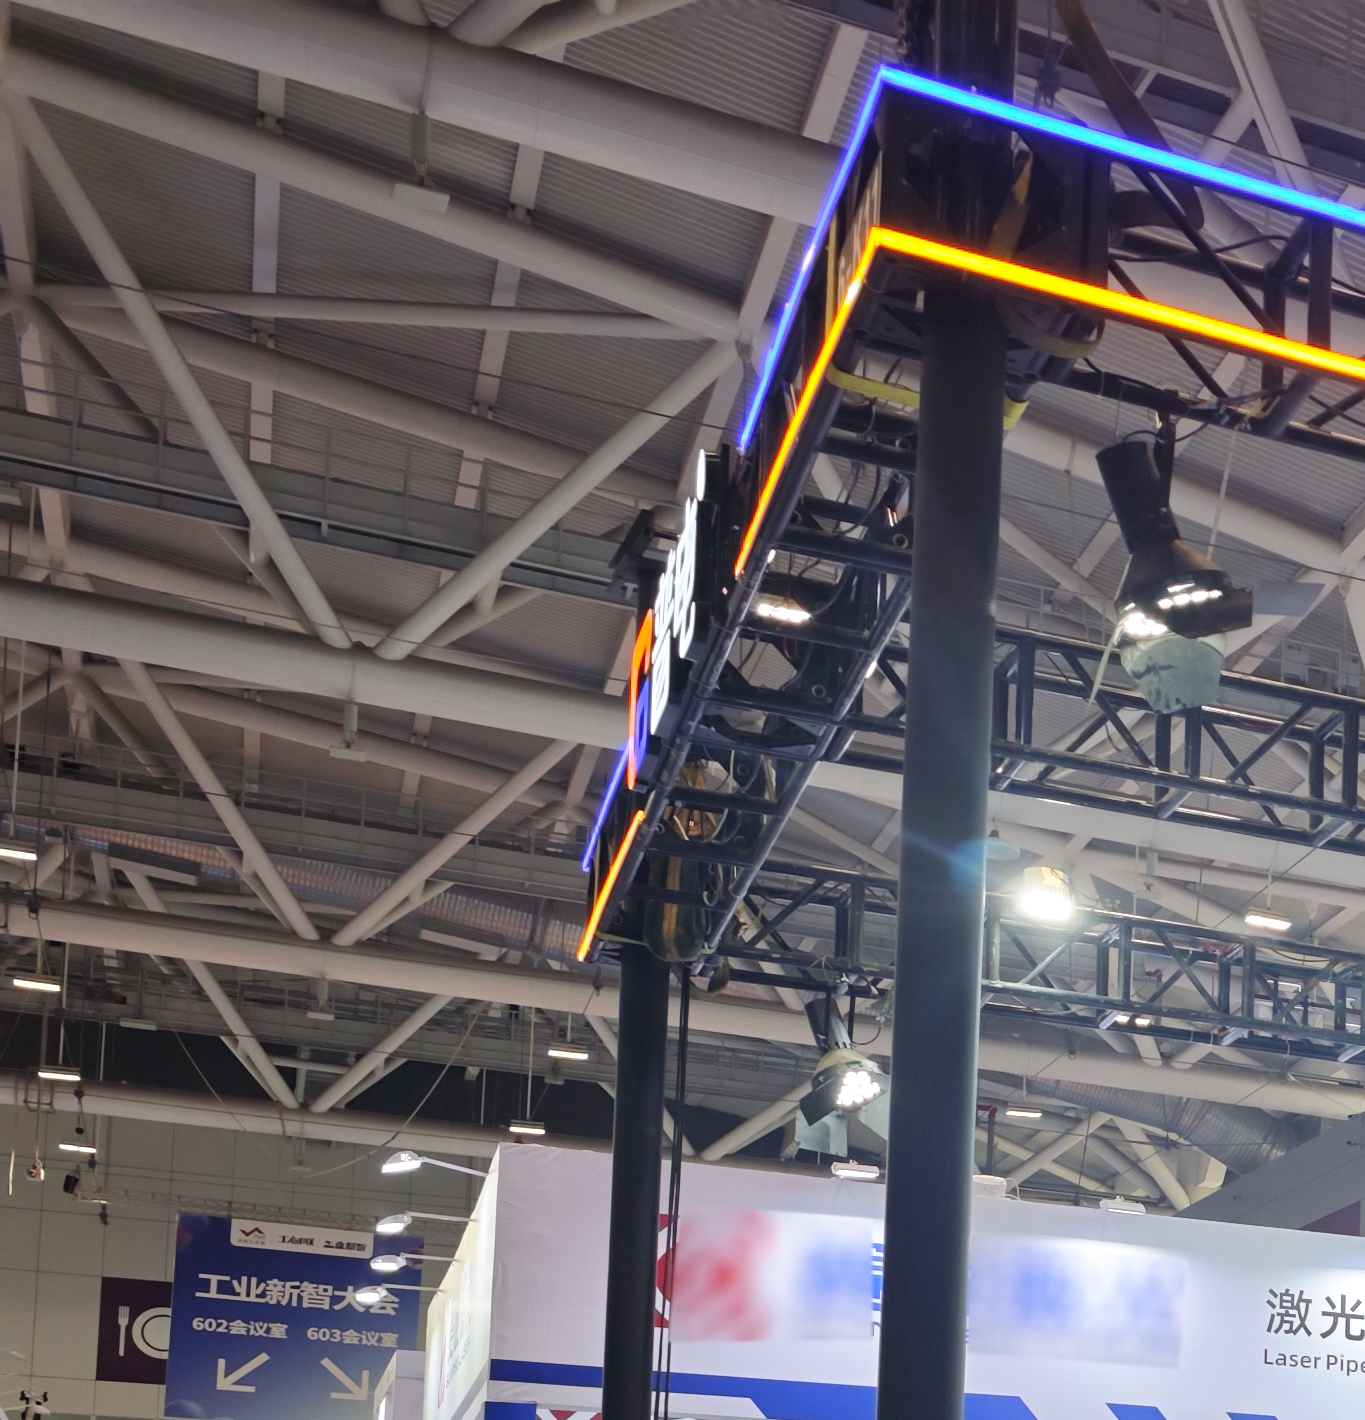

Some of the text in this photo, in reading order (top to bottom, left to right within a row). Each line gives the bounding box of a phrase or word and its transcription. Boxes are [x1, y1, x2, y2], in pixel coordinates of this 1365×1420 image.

[192, 1317, 288, 1339] 602会议室
[306, 1327, 399, 1348] 603会议室
[1263, 1349, 1321, 1370] Laser
